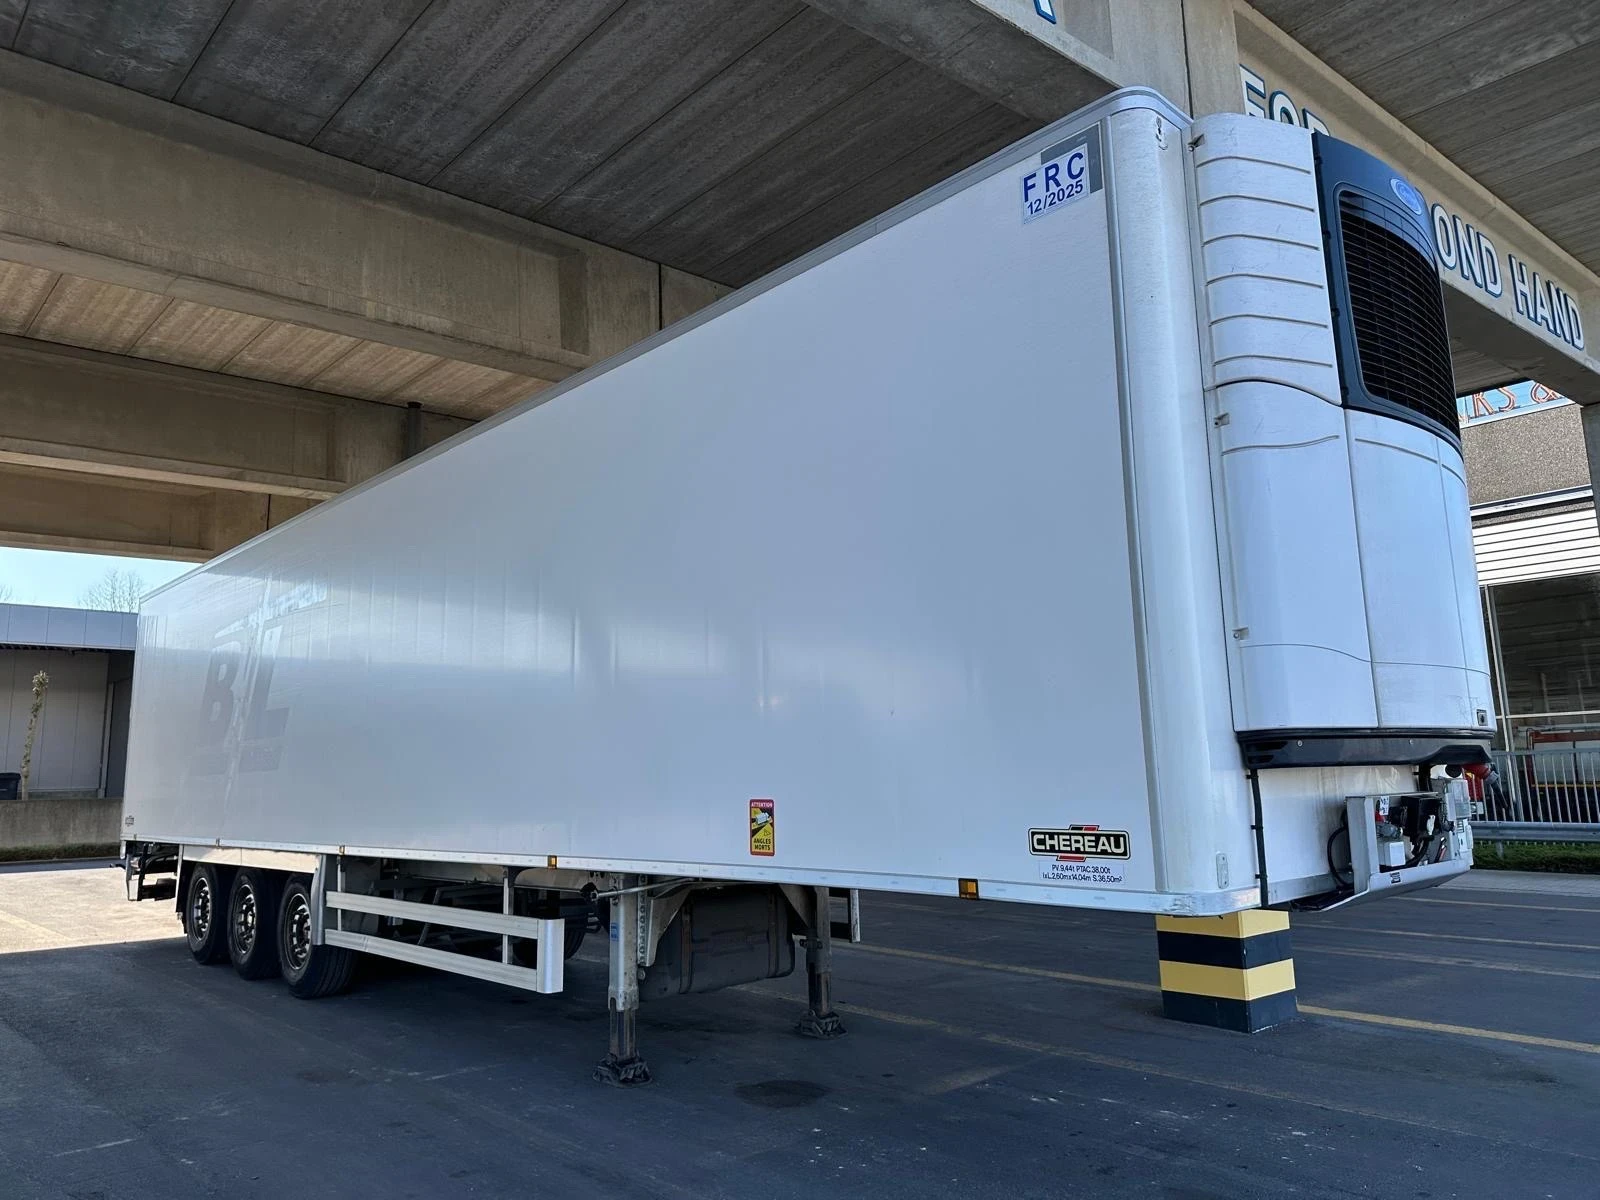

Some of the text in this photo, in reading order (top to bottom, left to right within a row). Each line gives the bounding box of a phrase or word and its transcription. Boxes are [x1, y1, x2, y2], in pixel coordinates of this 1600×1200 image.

[1028, 179, 1084, 215] 12/2025
[1508, 253, 1585, 351] HAND
[1032, 833, 1125, 854] CHEREAU
